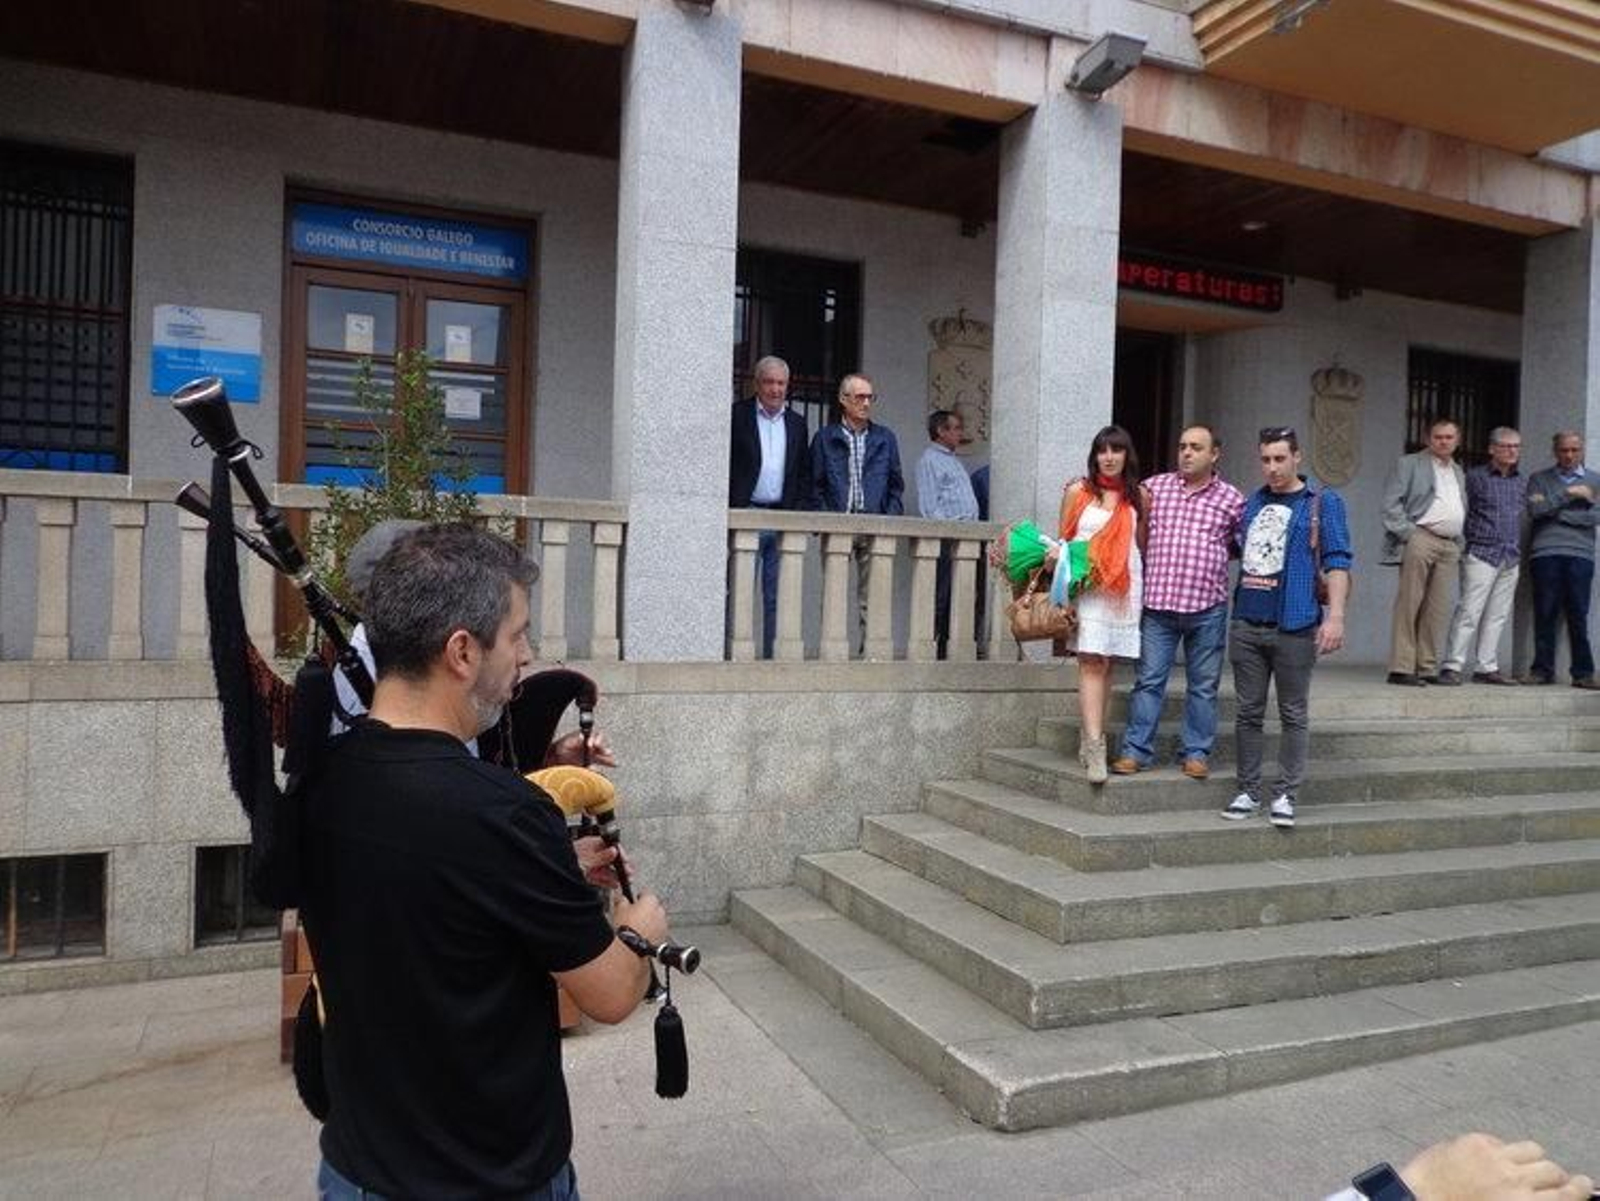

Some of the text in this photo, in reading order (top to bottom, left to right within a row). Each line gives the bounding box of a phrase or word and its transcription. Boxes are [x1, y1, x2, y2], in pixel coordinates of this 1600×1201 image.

[353, 218, 474, 247] CONSORCIO GALEGO
[306, 231, 516, 270] OFICINA DE IGUALDADE E BENESTAR
